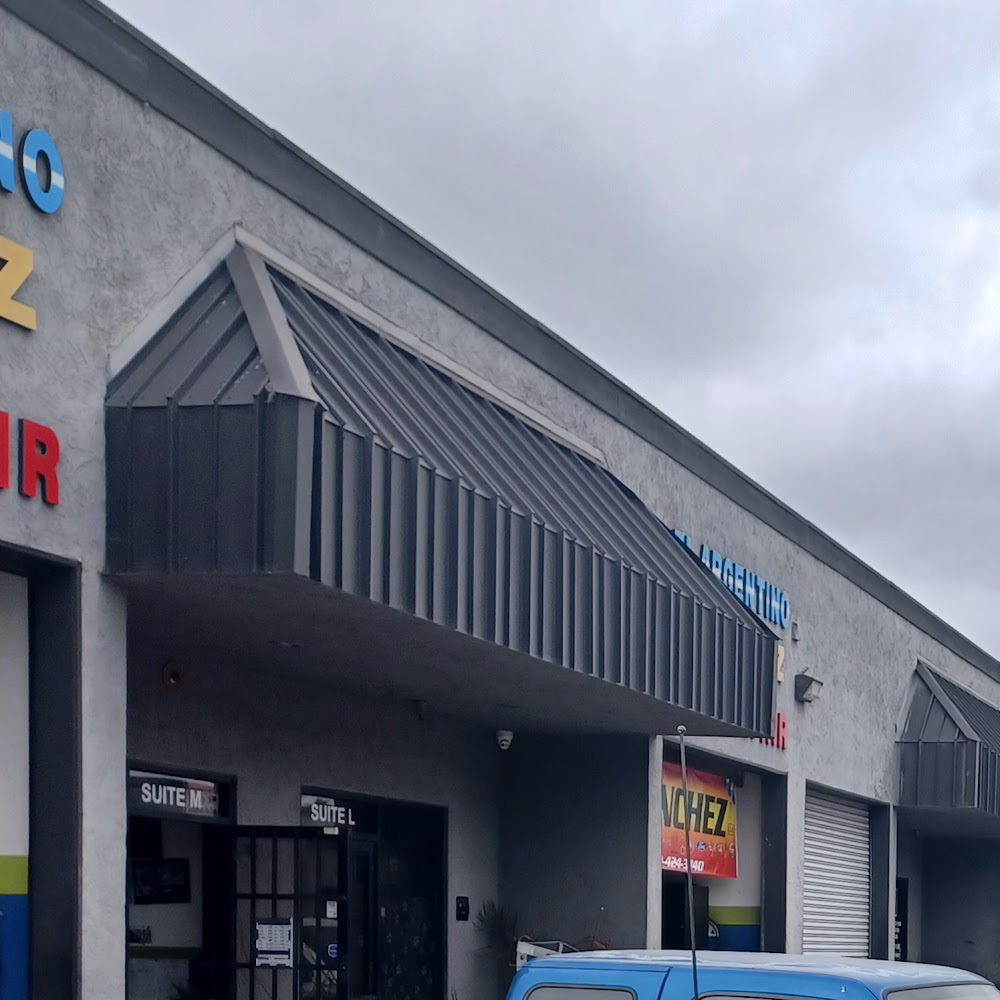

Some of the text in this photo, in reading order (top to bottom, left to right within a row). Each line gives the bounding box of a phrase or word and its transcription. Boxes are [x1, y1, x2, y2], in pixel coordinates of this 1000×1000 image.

[141, 782, 202, 809] SUITE M
[311, 803, 356, 825] SUITE L
